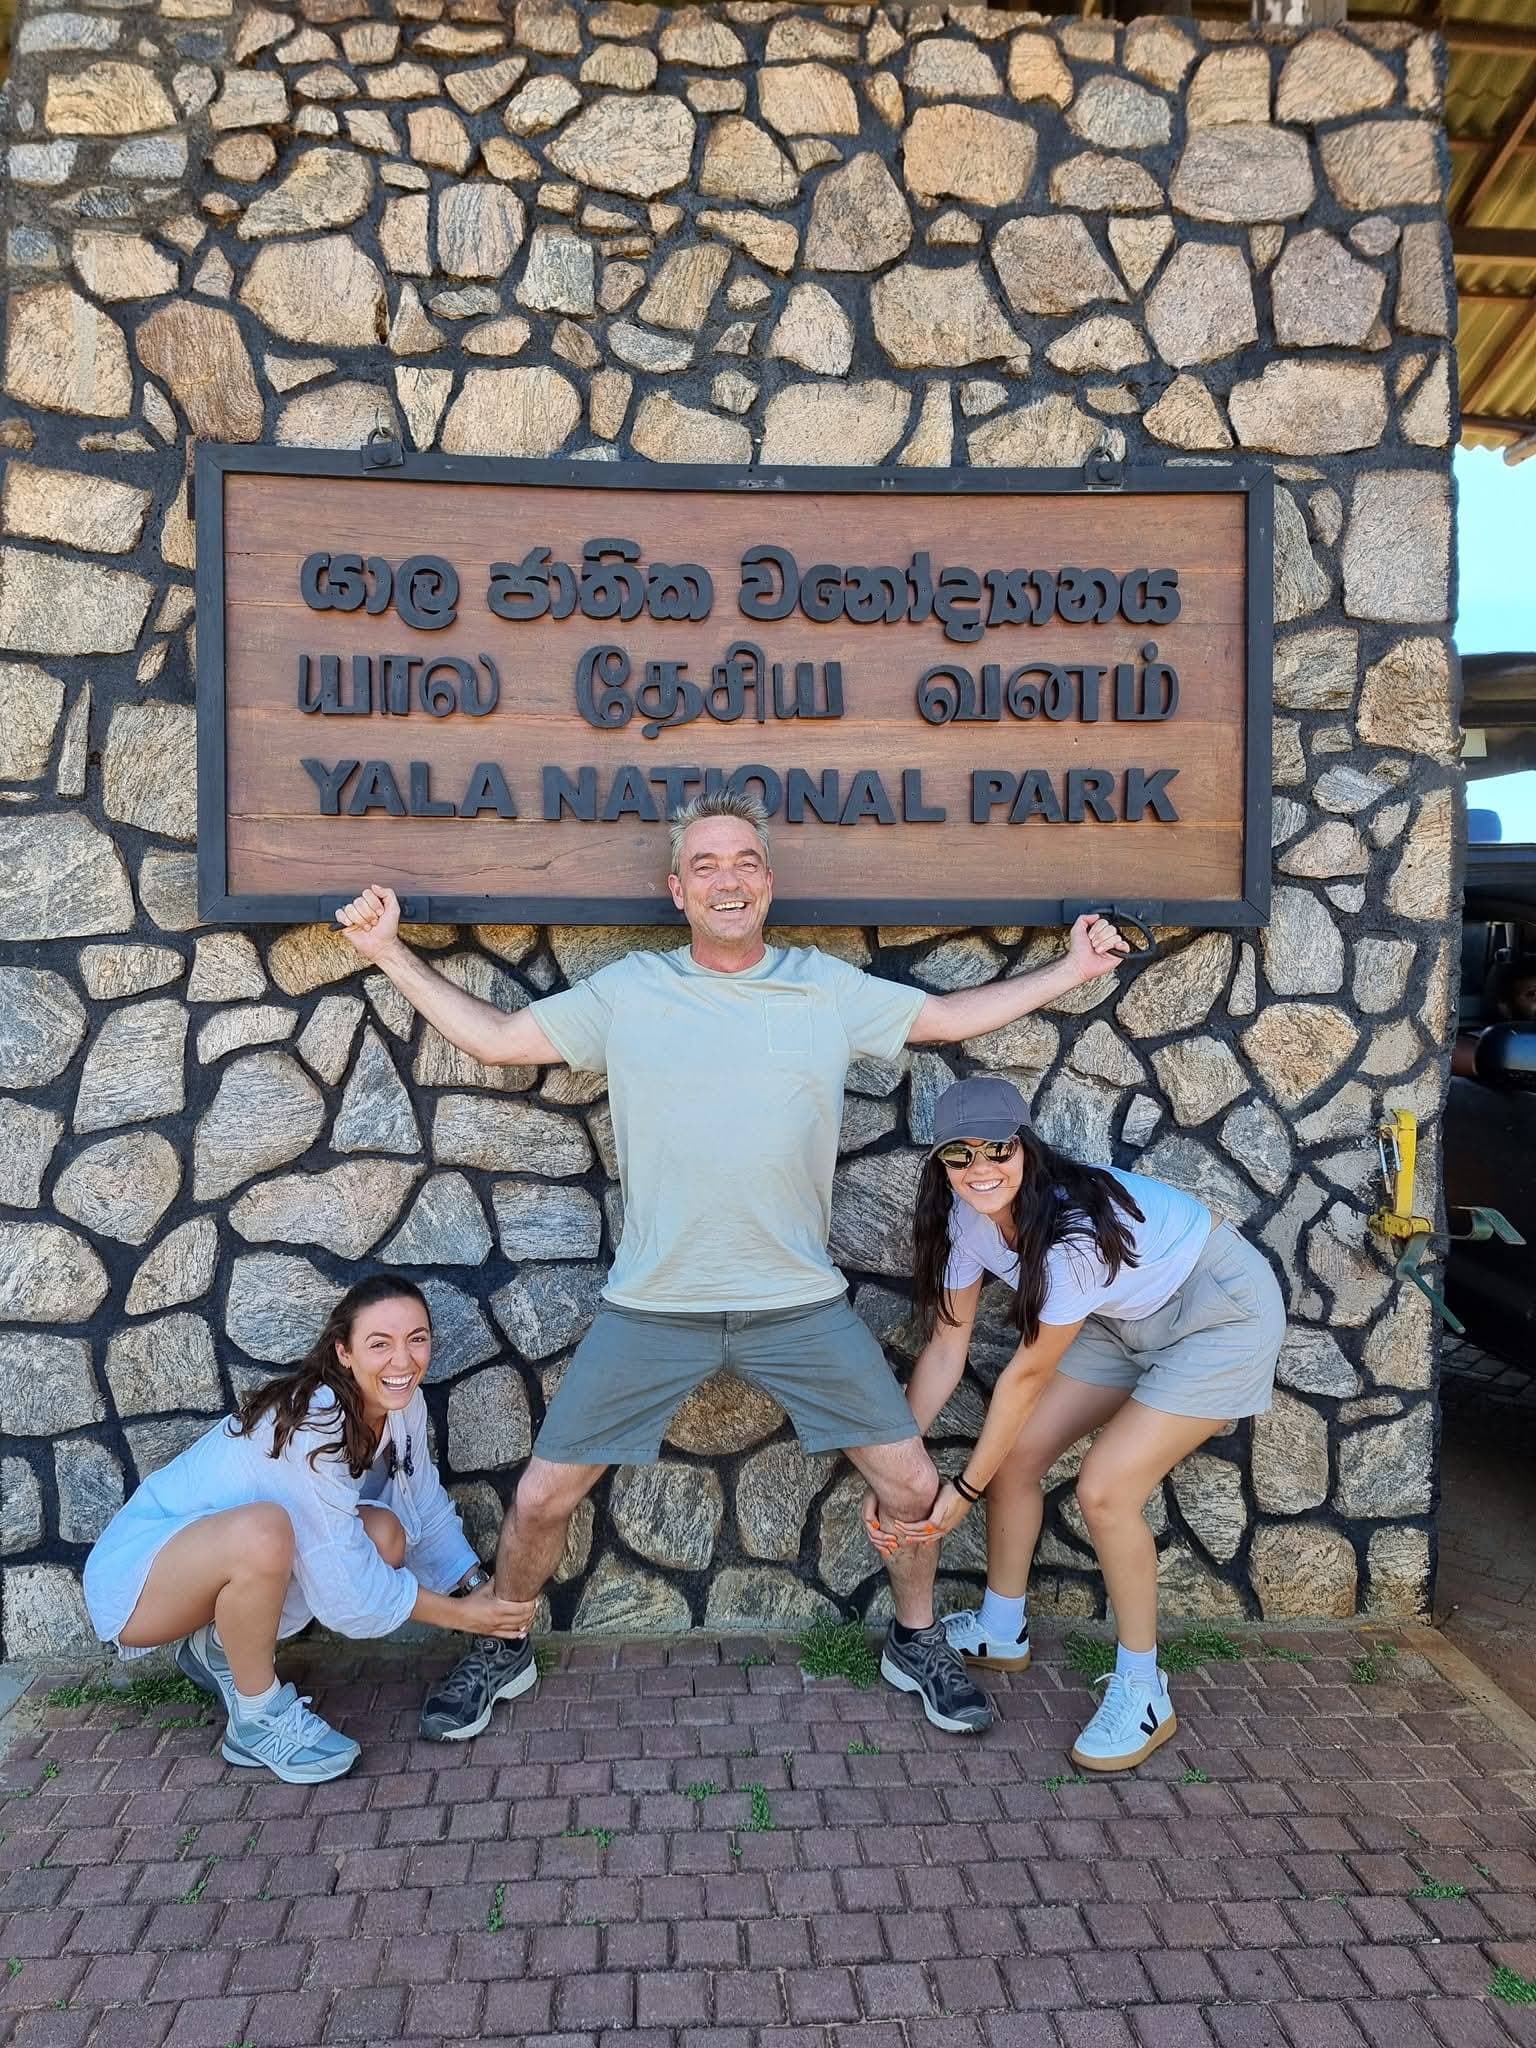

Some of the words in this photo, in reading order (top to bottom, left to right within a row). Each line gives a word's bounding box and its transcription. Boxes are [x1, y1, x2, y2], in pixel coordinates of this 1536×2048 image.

[300, 552, 460, 629] යාල
[487, 538, 714, 620] ජාතික
[297, 653, 500, 717] யால
[576, 642, 845, 738] தேசிய
[917, 641, 1179, 724] வனம்
[301, 759, 518, 818] YALA
[971, 768, 1180, 824] PARK
